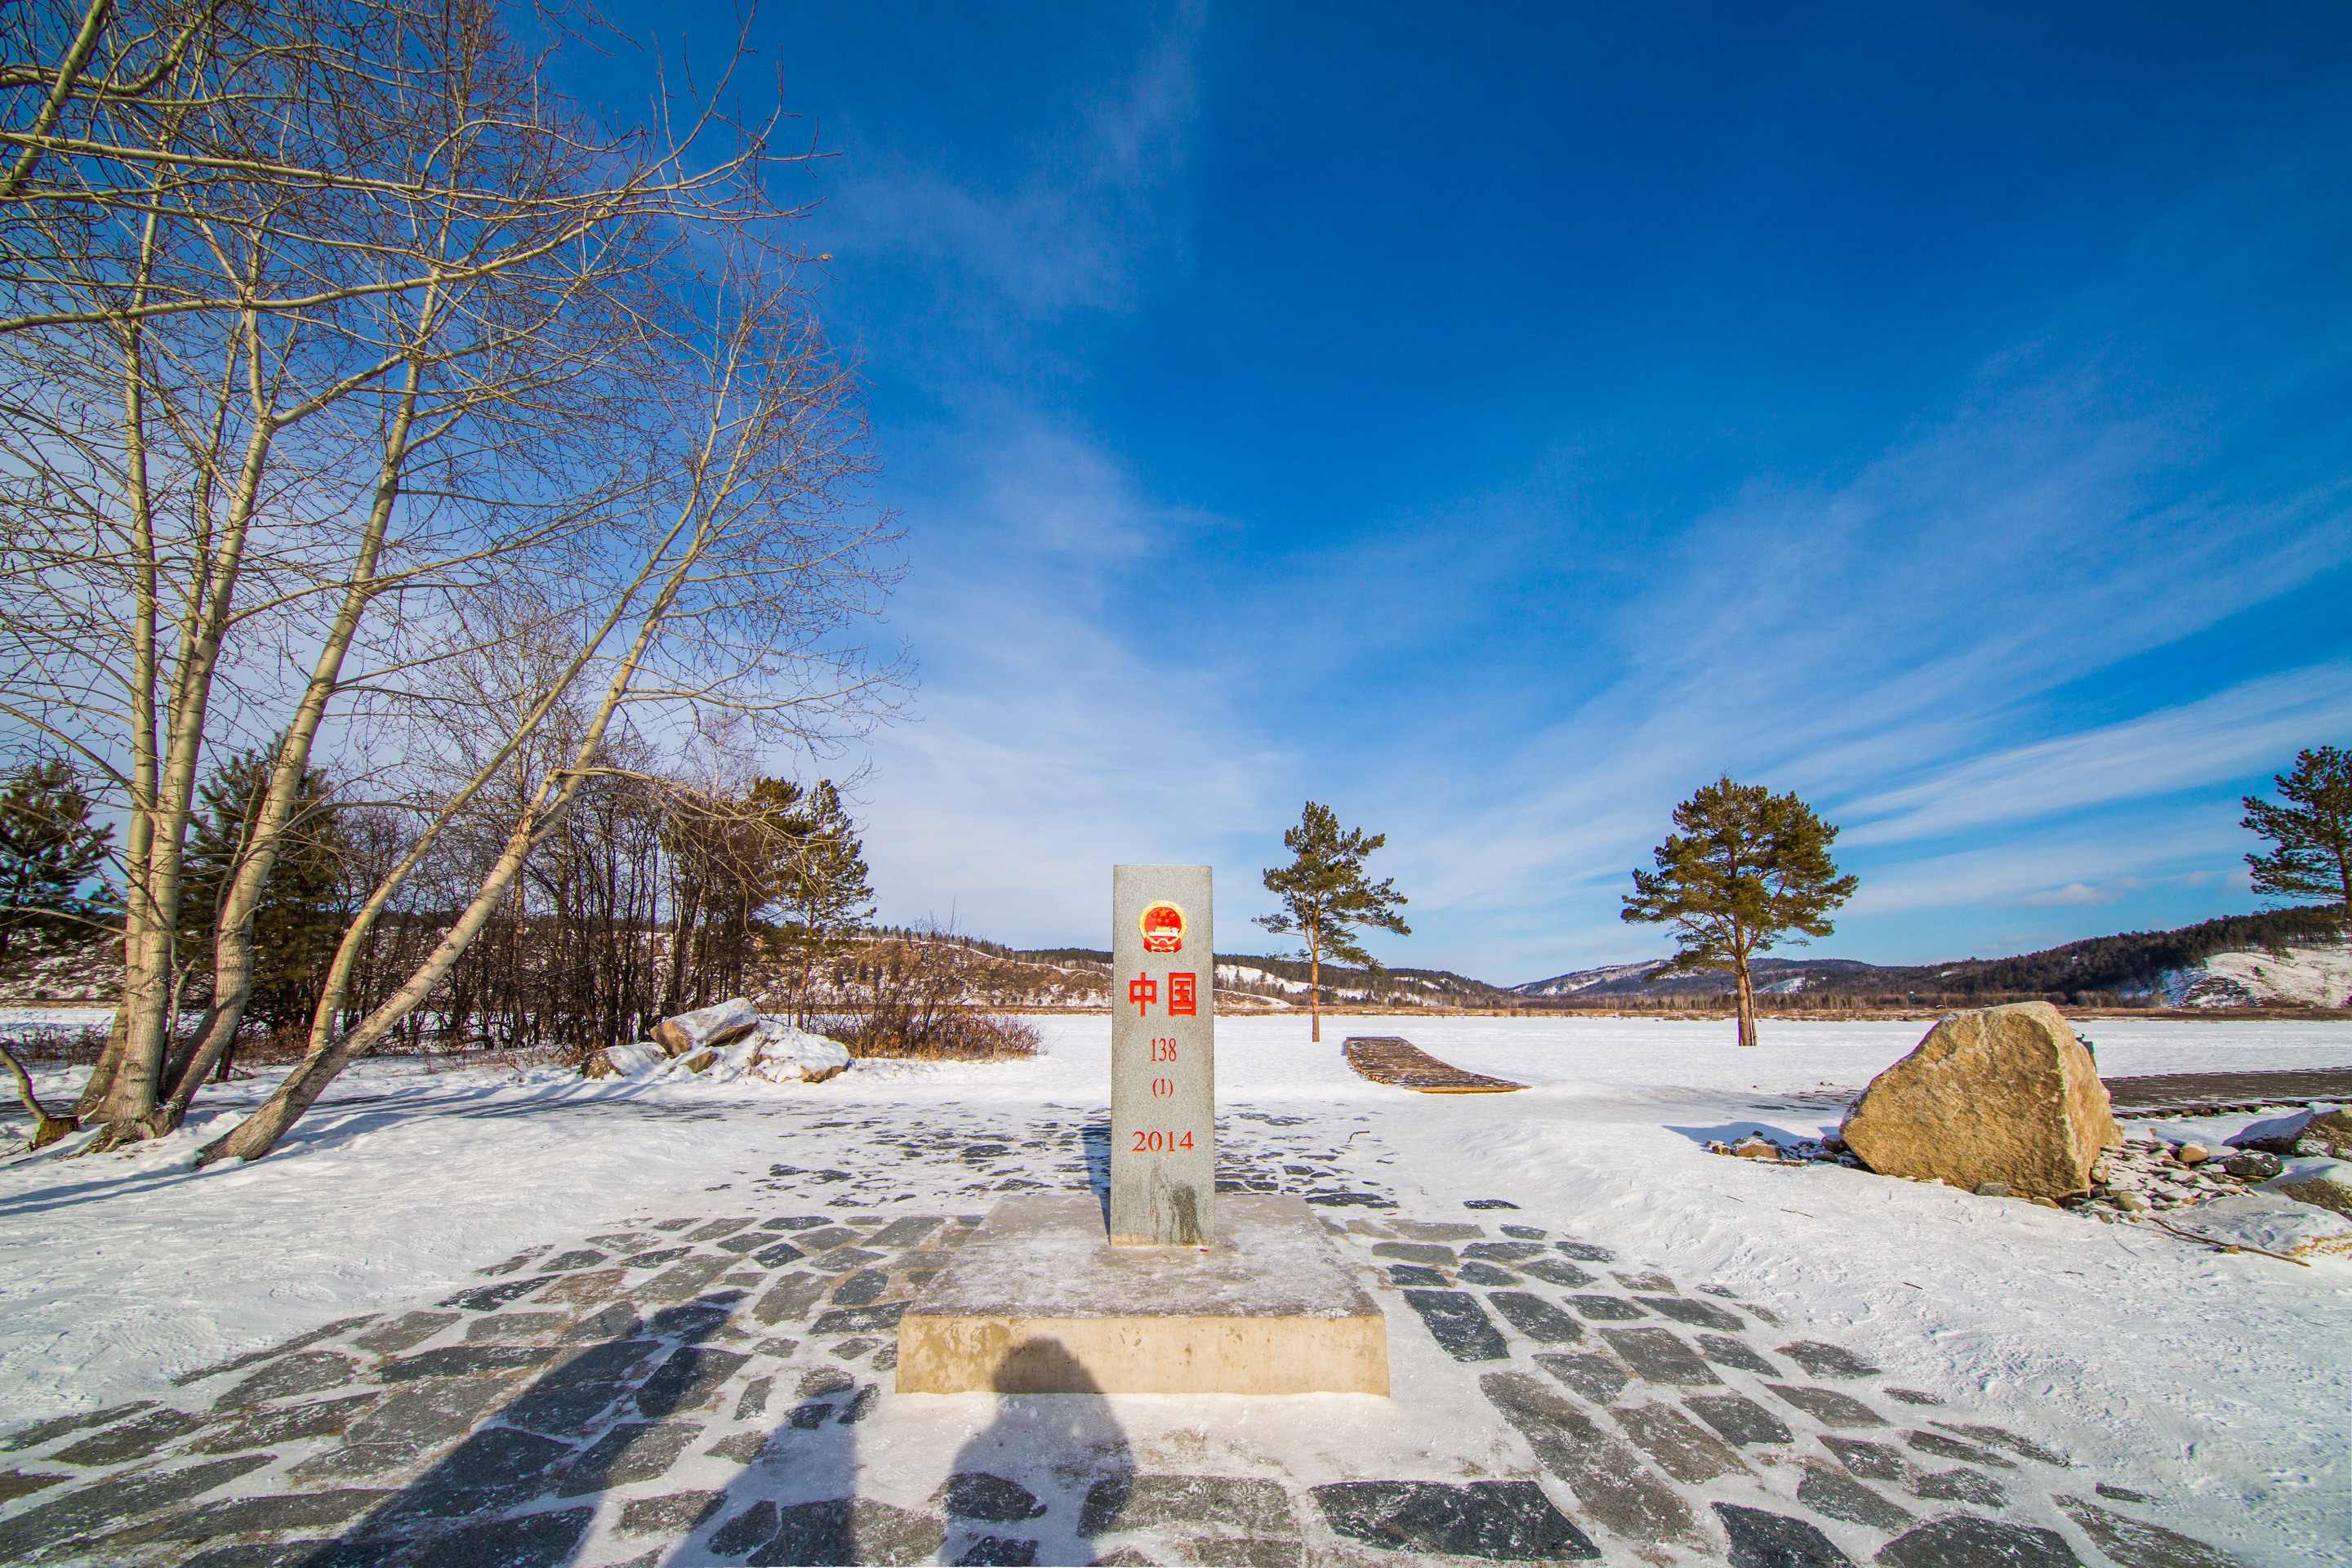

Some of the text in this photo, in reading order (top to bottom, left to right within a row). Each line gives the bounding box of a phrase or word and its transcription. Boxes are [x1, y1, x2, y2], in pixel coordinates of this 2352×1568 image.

[1129, 972, 1197, 1018] 中国
[1151, 1038, 1177, 1062] 138
[1152, 1078, 1174, 1098] (1)
[1131, 1130, 1195, 1152] 2014
